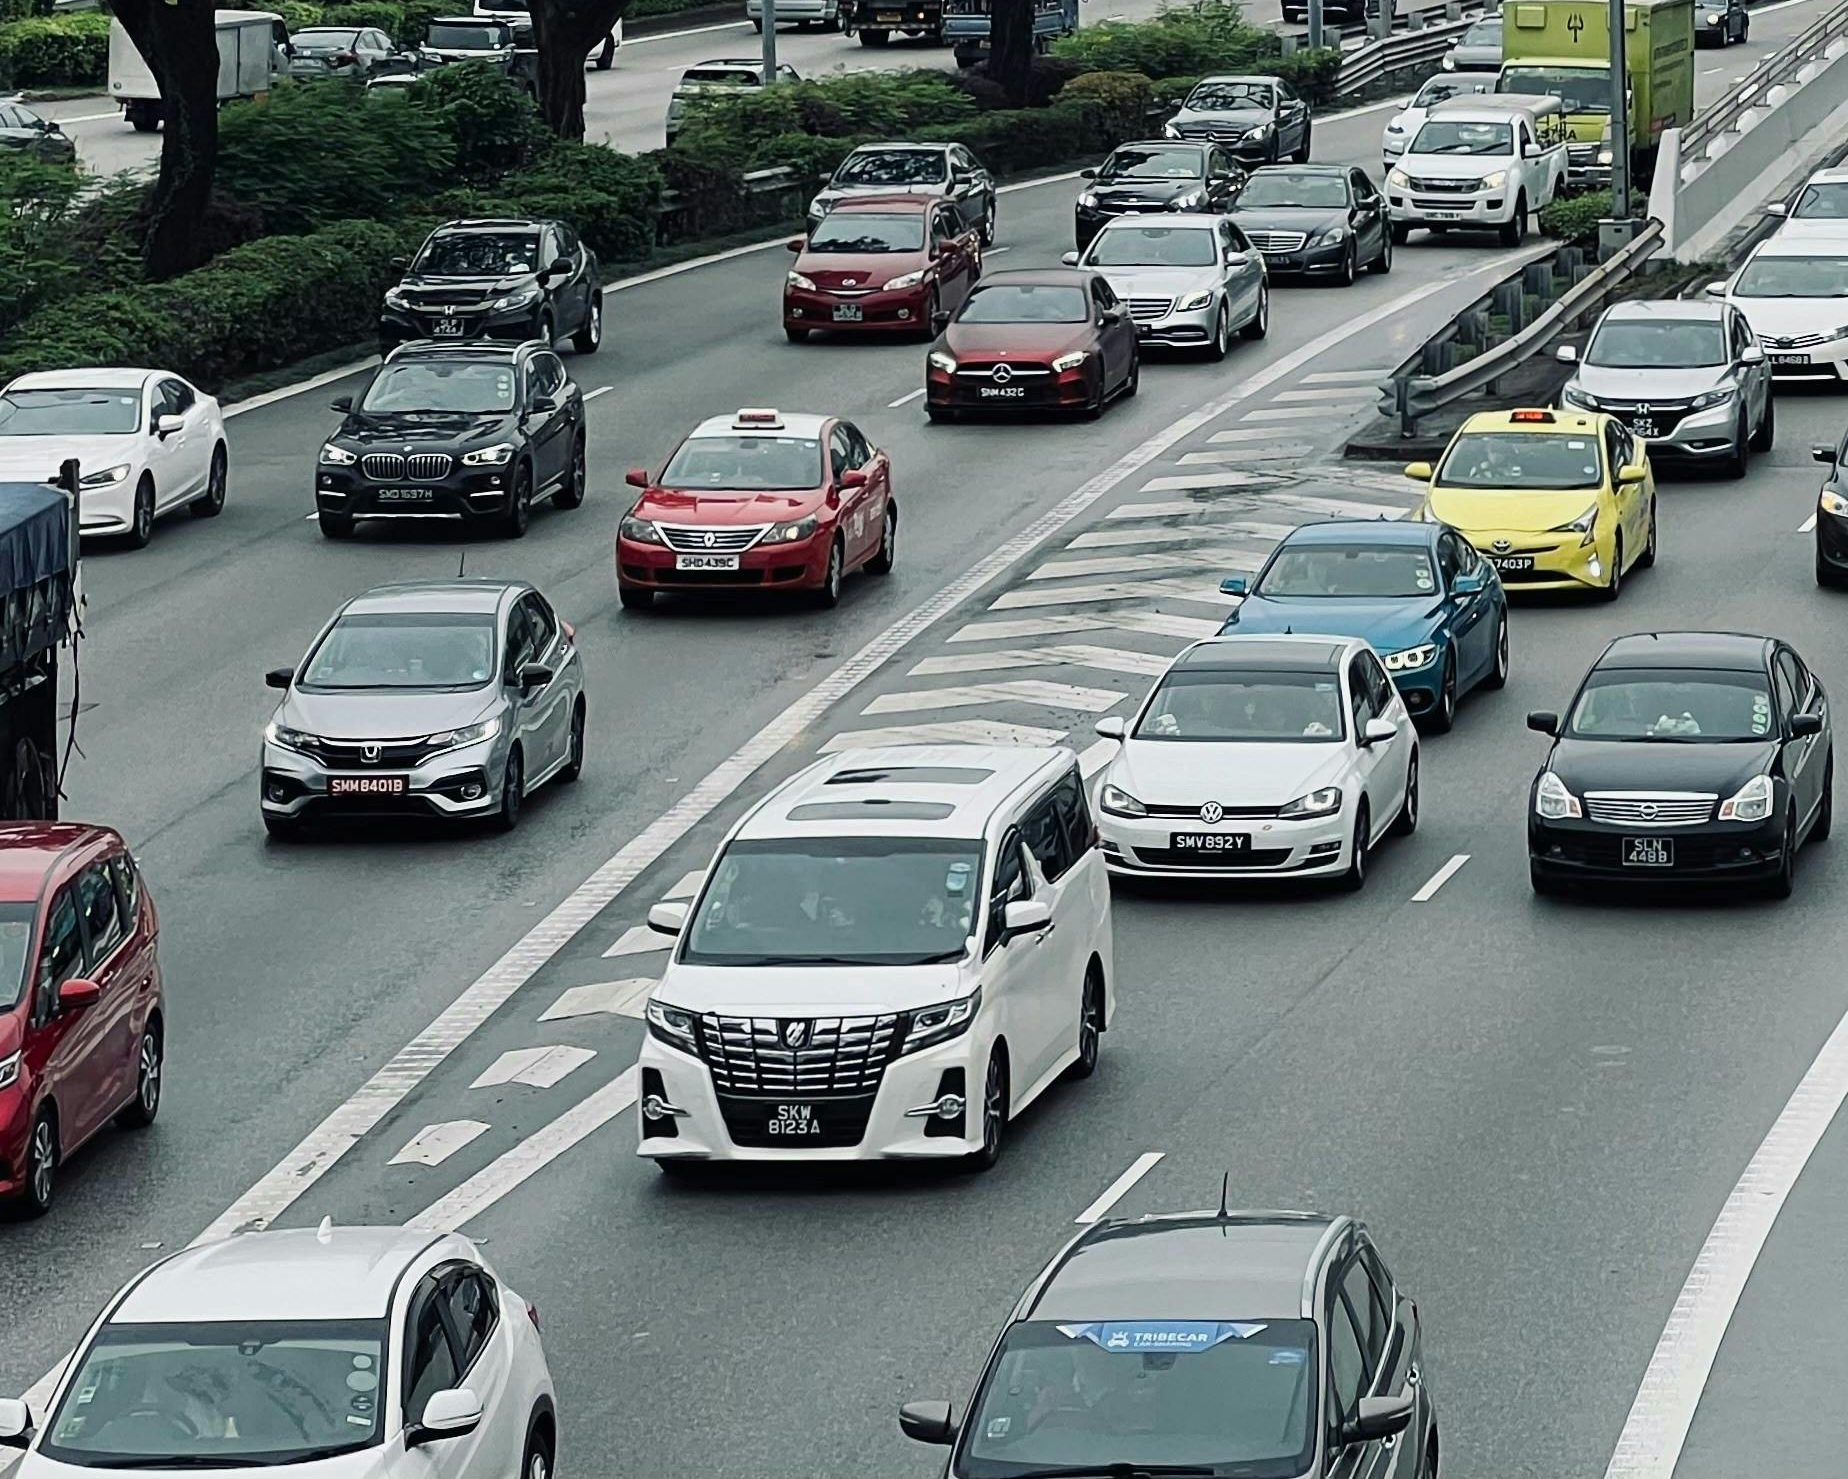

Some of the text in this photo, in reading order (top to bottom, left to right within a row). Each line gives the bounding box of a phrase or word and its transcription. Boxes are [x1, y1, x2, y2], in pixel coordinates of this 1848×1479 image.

[1634, 837, 1662, 852] SLN
[777, 1104, 812, 1120] SKW
[1133, 1331, 1209, 1343] TRIBECAR
